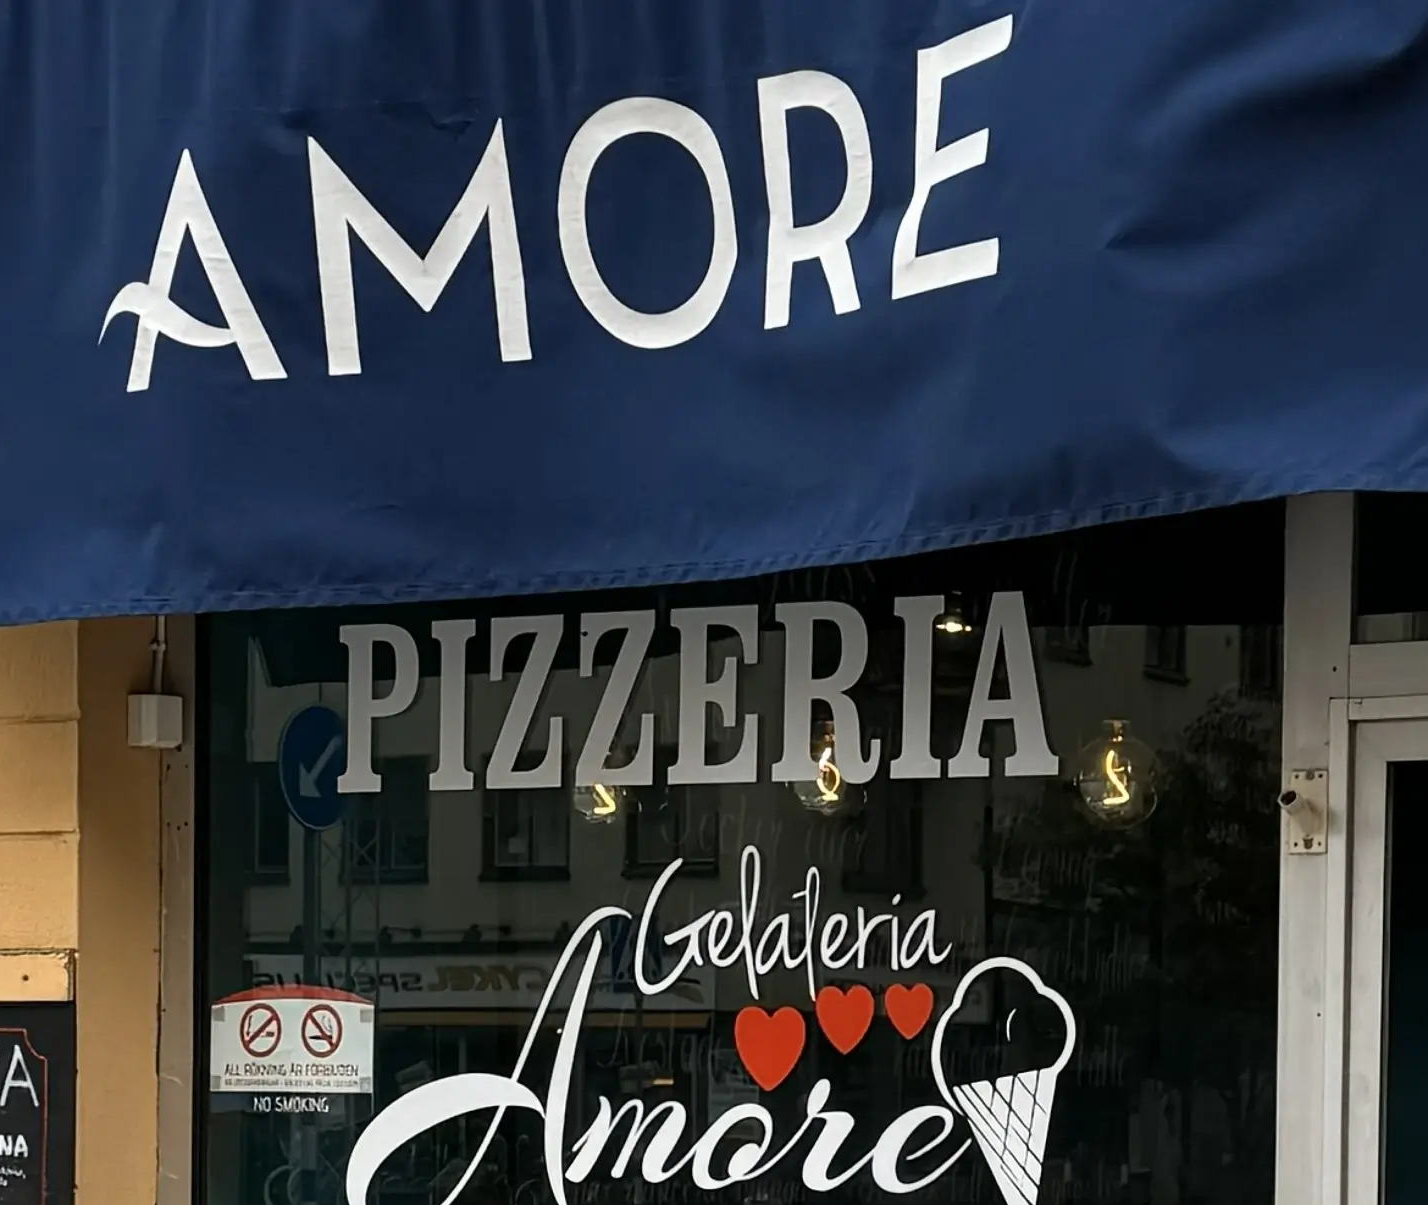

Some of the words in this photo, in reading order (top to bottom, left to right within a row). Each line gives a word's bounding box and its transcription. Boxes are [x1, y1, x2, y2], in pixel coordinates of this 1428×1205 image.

[99, 14, 1013, 393] AMORE
[335, 591, 1059, 794] PIZZERIA
[634, 845, 952, 1000] Gelateria
[253, 1096, 272, 1113] NO
[275, 1096, 330, 1113] SMOKING
